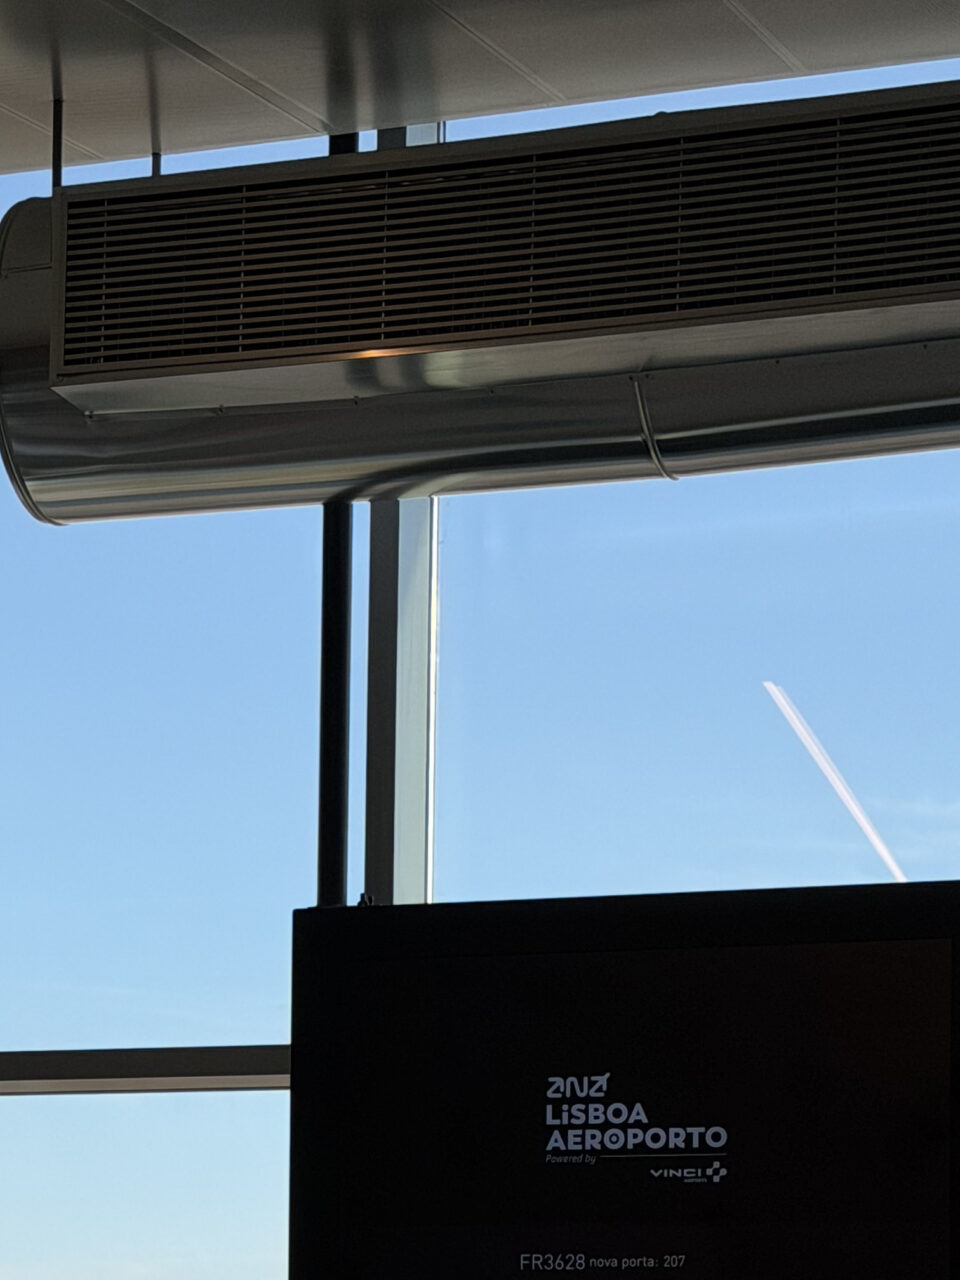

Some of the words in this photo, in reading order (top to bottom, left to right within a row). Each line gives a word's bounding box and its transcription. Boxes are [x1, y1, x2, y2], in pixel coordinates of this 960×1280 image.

[545, 1126, 728, 1150] AEROPORTO
[545, 1154, 583, 1164] Powered
[584, 1153, 597, 1165] by
[649, 1167, 702, 1178] VINCI
[519, 1253, 586, 1270] FR3628
[589, 1257, 618, 1268] nova
[621, 1256, 658, 1269] porta:
[663, 1255, 686, 1268] 207
